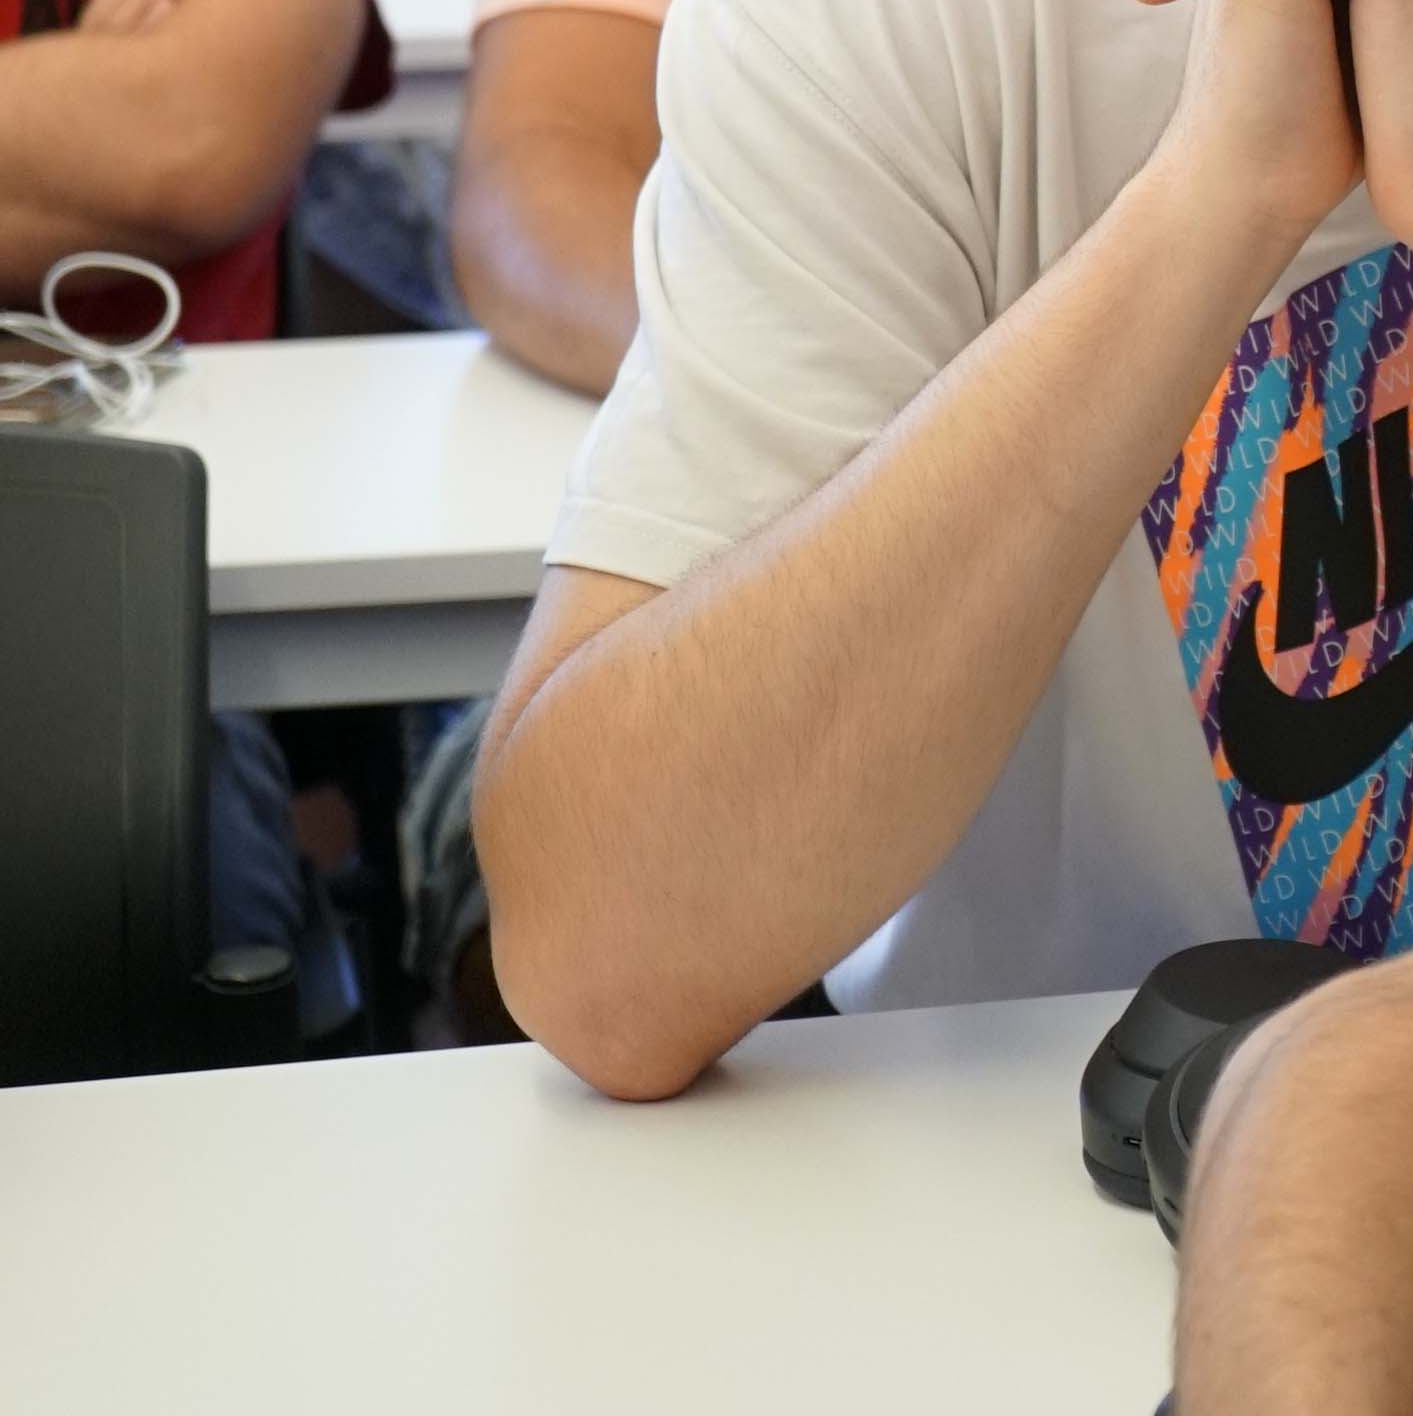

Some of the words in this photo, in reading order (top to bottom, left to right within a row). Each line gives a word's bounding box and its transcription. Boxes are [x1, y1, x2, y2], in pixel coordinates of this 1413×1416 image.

[1291, 261, 1381, 320] WILD
[1270, 320, 1338, 380] WILD
[1231, 382, 1315, 432] WILD
[1320, 328, 1407, 388] WILD
[1189, 437, 1279, 475] WILD
[1147, 487, 1236, 525] WILD
[1163, 558, 1257, 595] WILD
[1247, 830, 1342, 869] WILD
[1309, 838, 1404, 889] WILD
[1265, 895, 1363, 934] WILD
